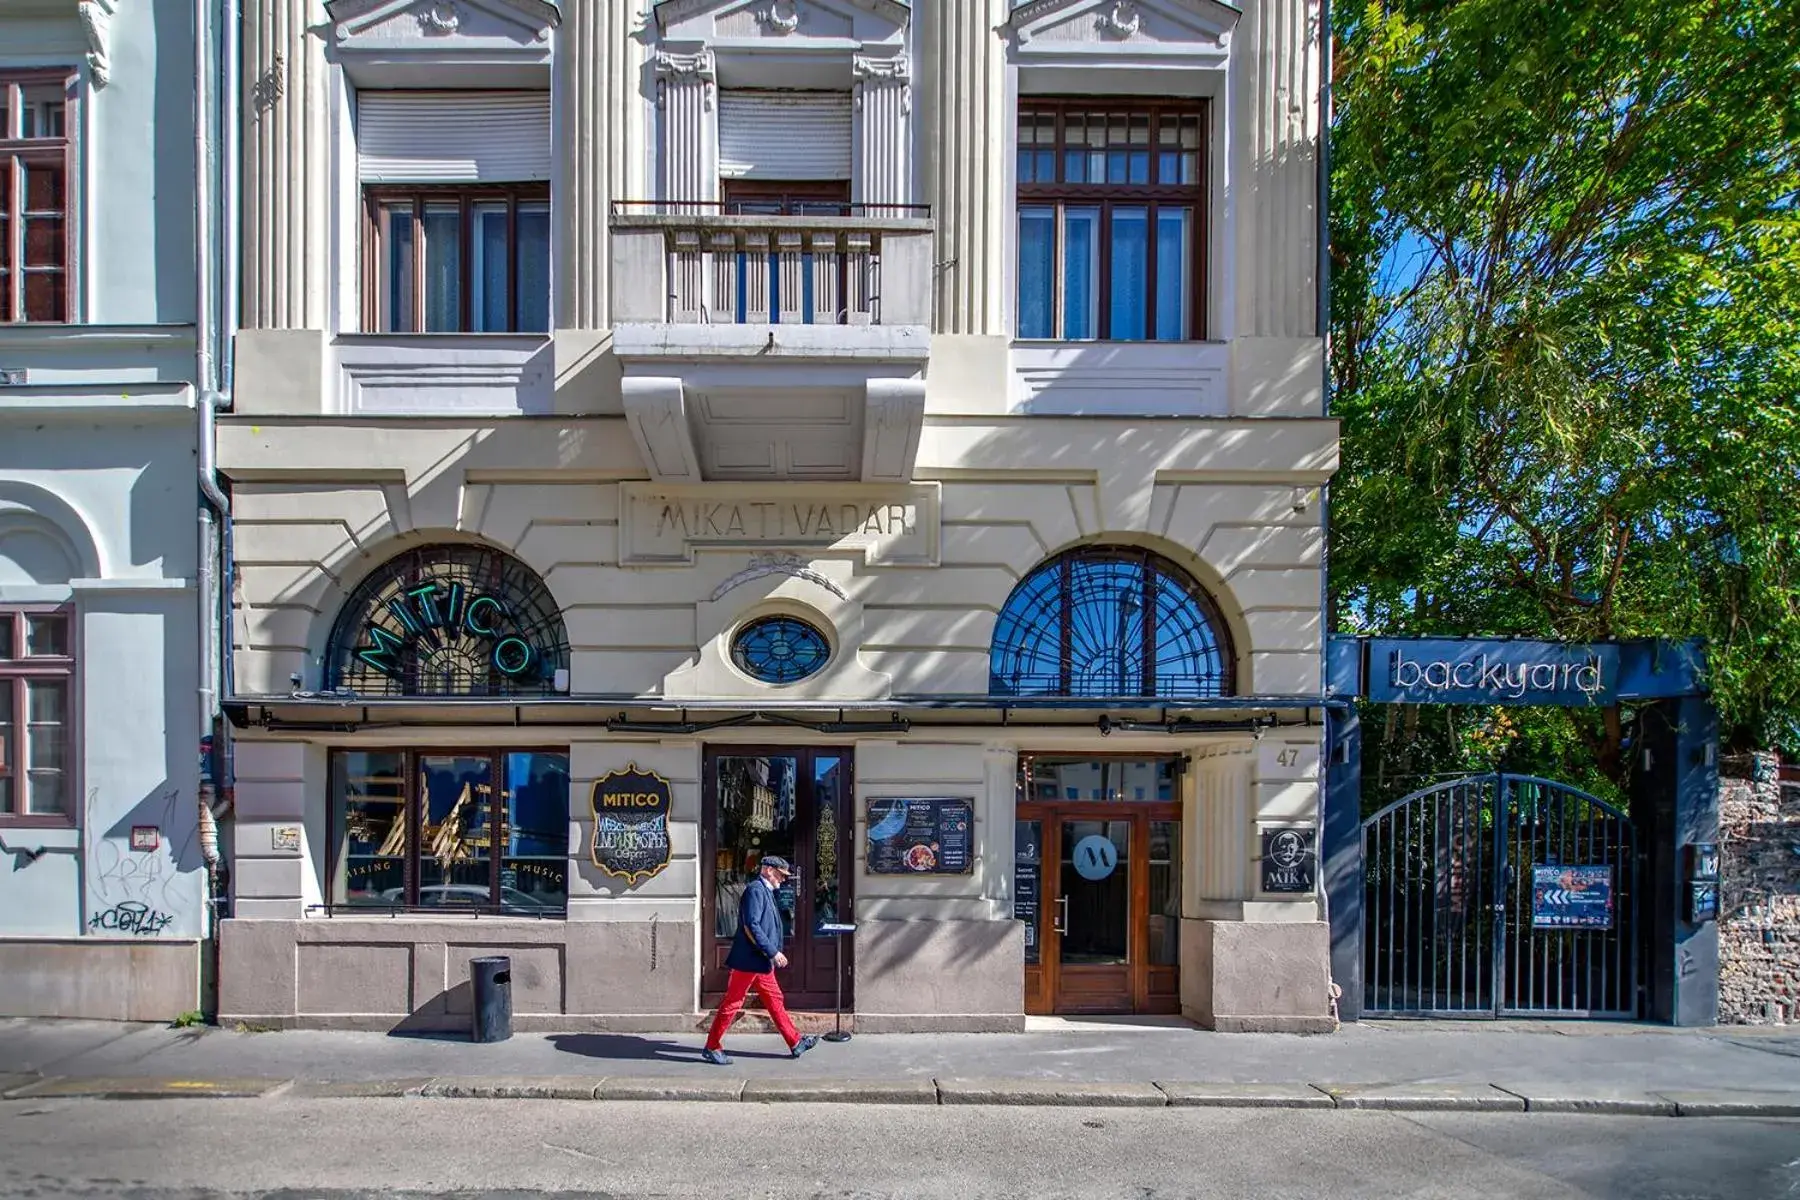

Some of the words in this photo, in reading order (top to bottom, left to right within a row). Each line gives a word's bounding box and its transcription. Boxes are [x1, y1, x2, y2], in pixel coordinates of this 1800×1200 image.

[356, 582, 533, 675] MITICO
[1394, 648, 1604, 698] backyard
[1276, 748, 1299, 768] 47
[603, 792, 660, 807] MITICO
[522, 864, 563, 883] MUSIC
[1266, 871, 1311, 884] MIKA
